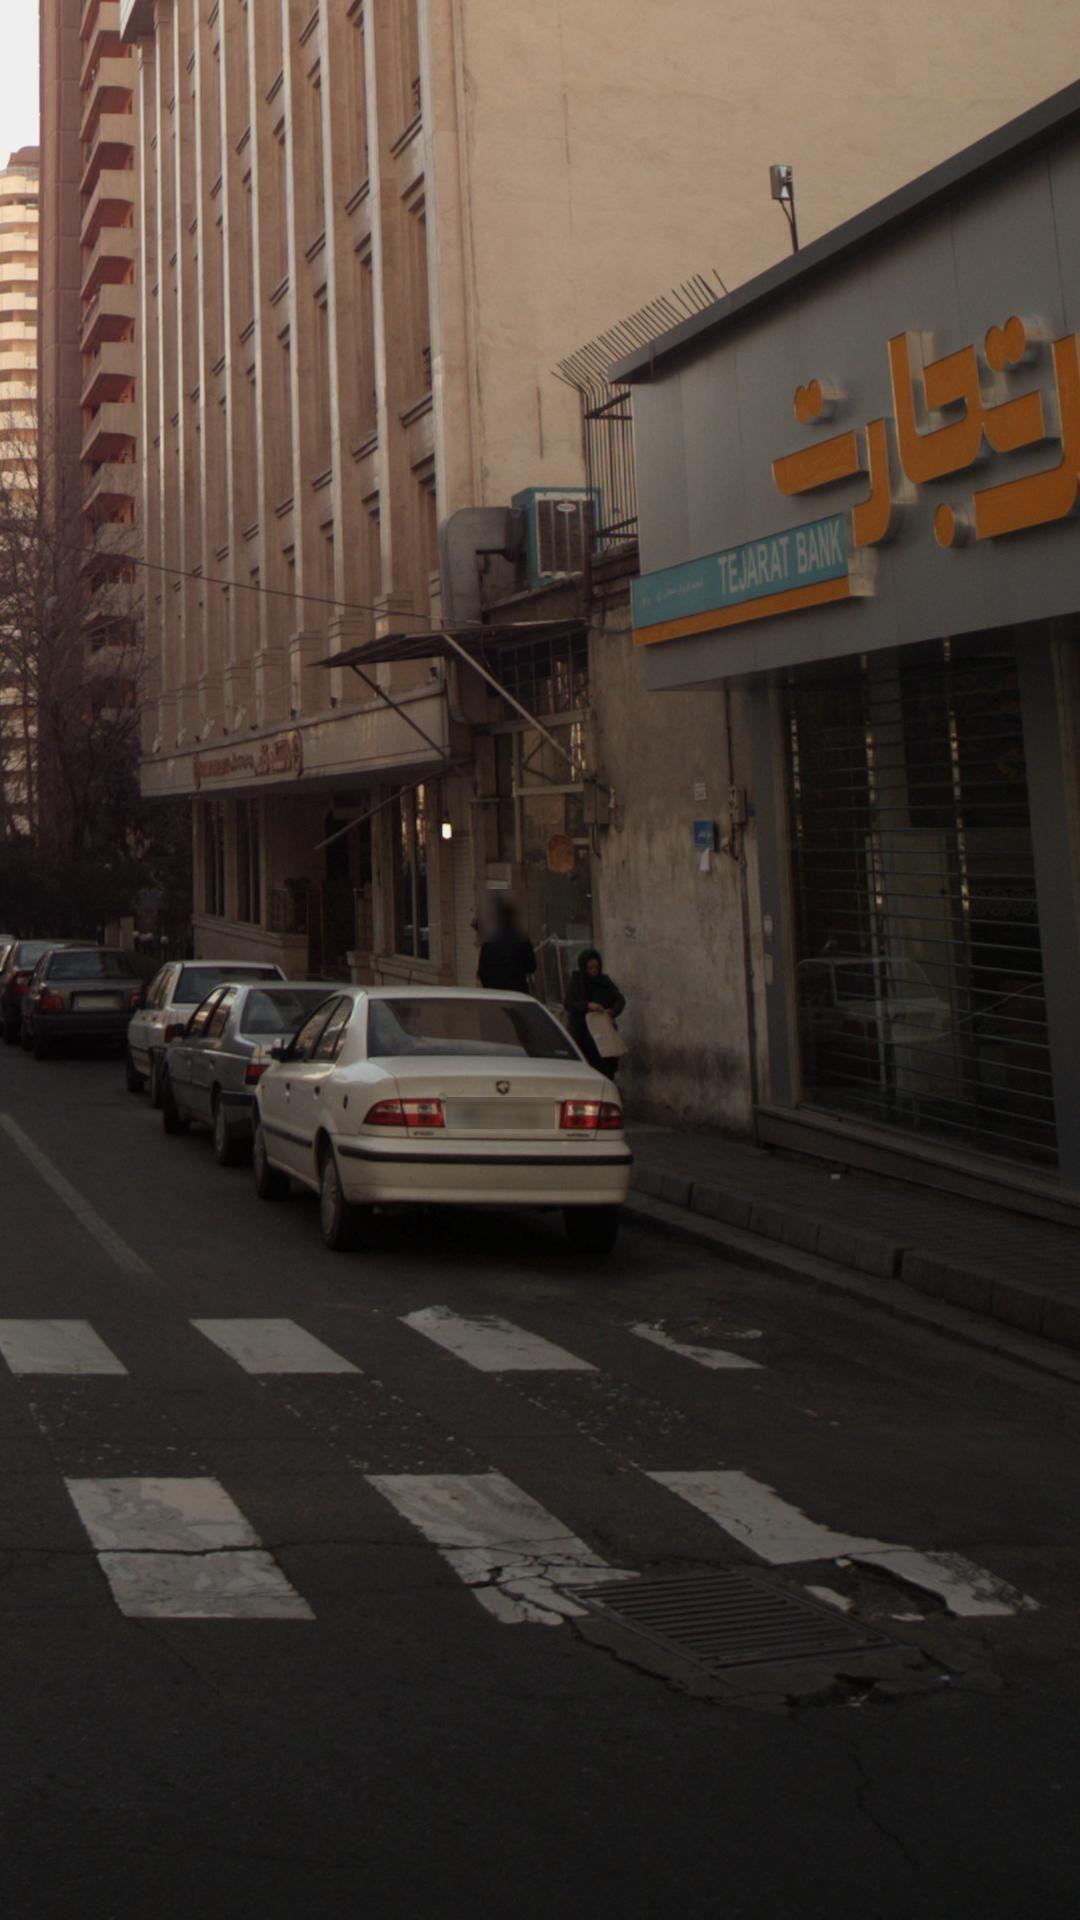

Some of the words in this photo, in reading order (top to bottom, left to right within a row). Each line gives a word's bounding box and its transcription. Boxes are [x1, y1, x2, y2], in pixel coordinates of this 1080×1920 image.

[772, 316, 1045, 548] تجارت
[718, 536, 789, 594] TEJARAT
[796, 520, 843, 574] BANK
